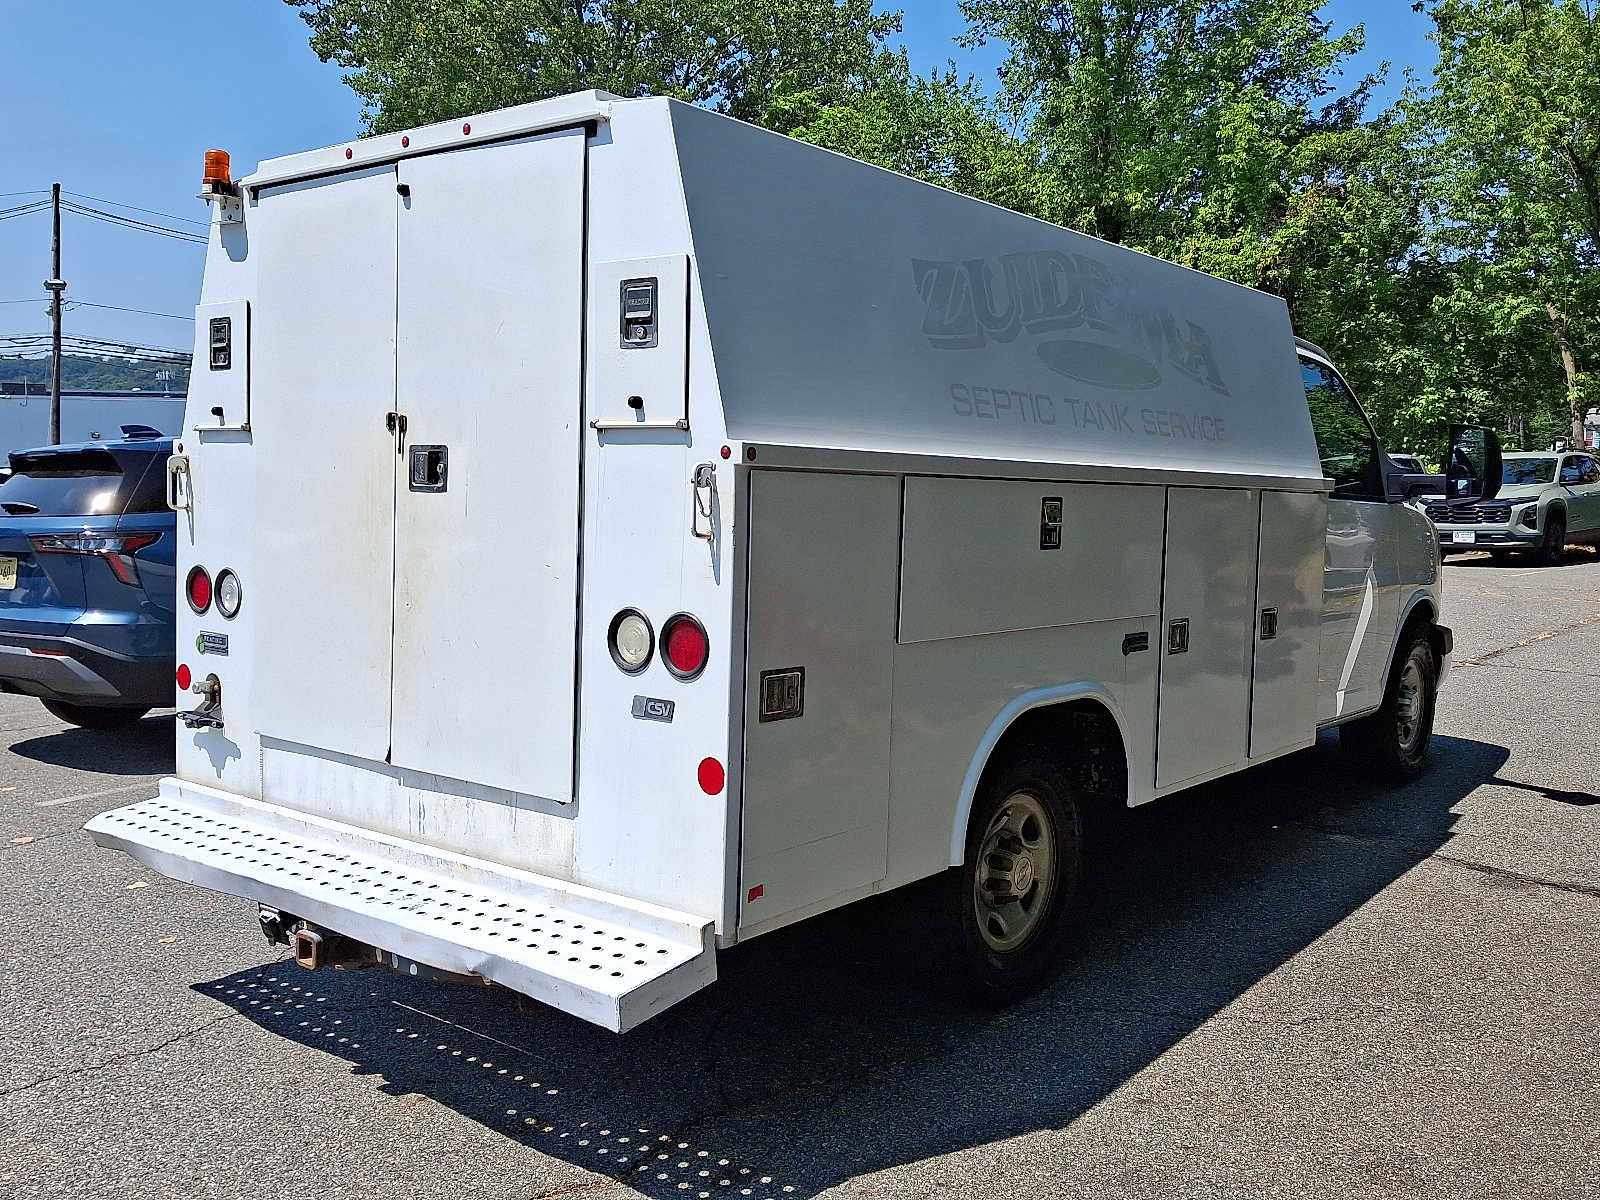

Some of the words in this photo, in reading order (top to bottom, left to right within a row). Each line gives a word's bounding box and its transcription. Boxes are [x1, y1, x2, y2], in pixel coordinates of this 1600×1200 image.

[951, 384, 1055, 425] SEPTIC
[1064, 398, 1134, 433] TANK
[1140, 409, 1226, 441] SERVICE
[647, 702, 671, 717] CSV
